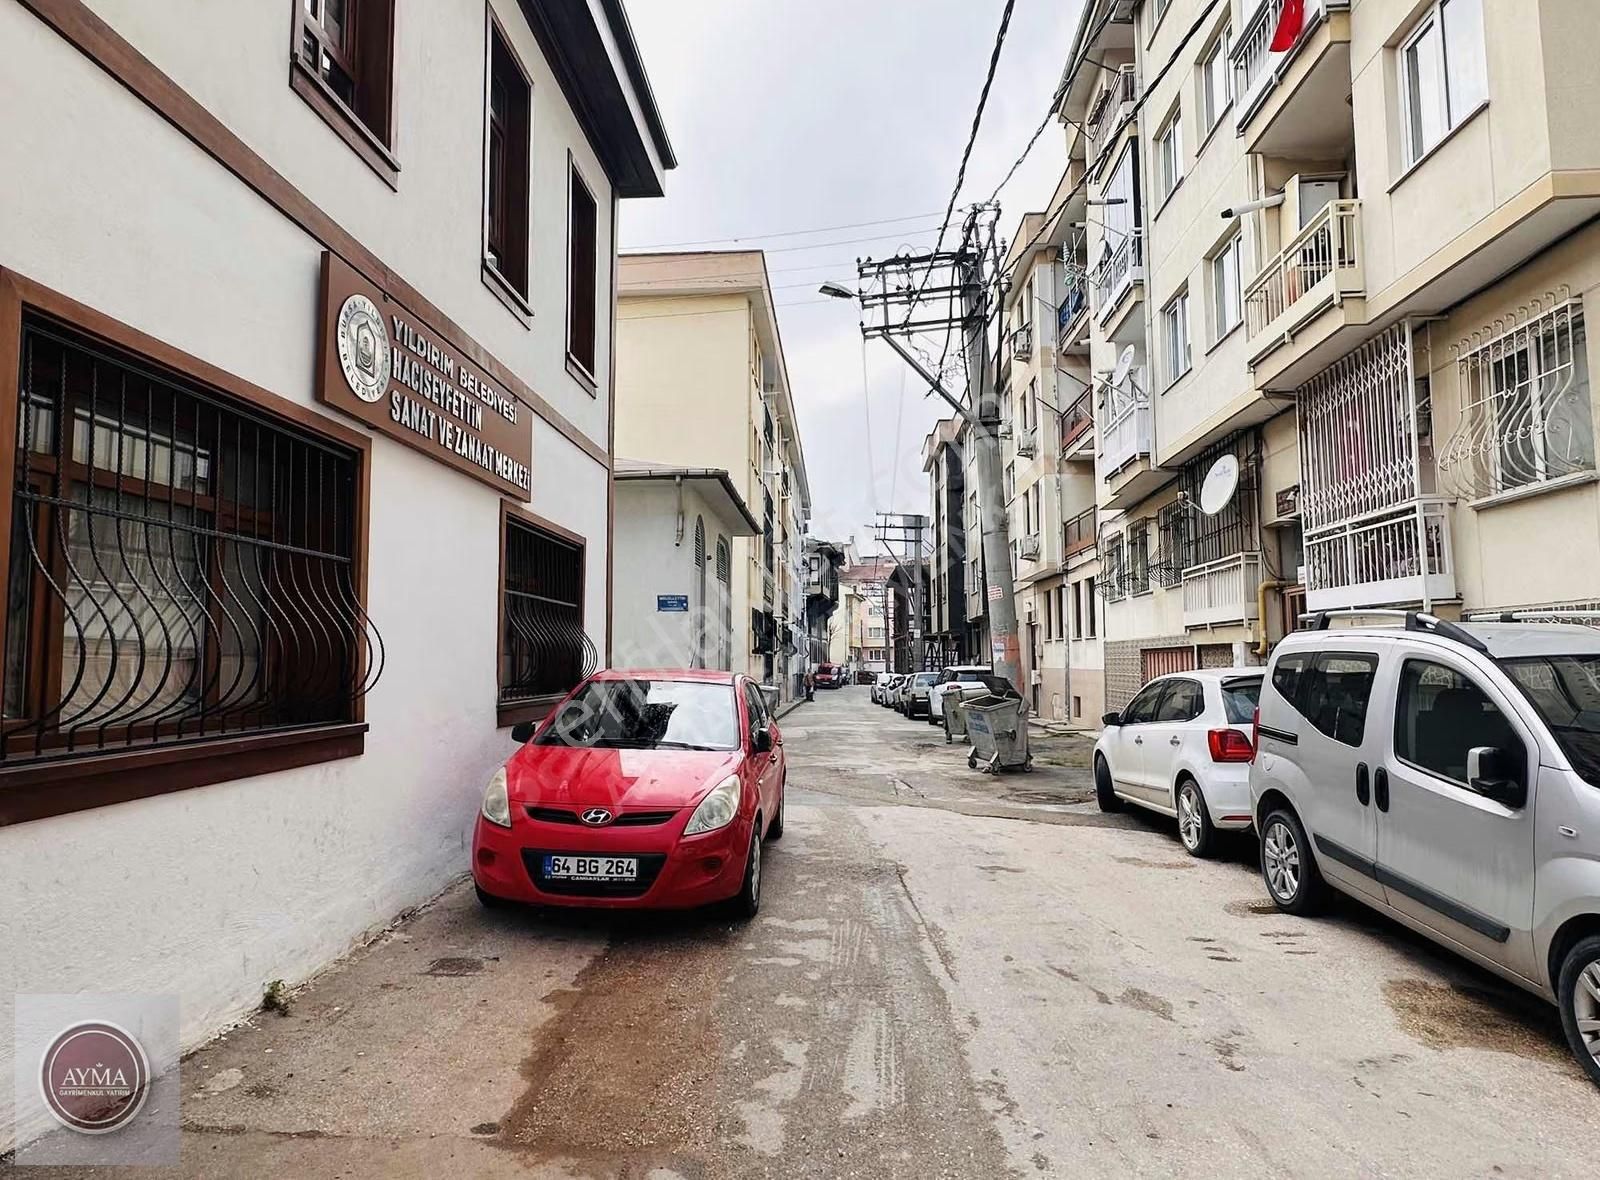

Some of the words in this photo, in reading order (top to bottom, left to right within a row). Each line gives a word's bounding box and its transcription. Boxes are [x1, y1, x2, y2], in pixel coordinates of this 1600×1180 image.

[391, 315, 454, 379] YILDIRIM
[390, 389, 436, 440] SANAT
[438, 416, 453, 448] VE
[454, 426, 495, 472] ZANAAT
[495, 452, 531, 491] MERKEZİ
[552, 858, 571, 874] 64
[576, 859, 599, 874] BG
[605, 860, 635, 876] 264
